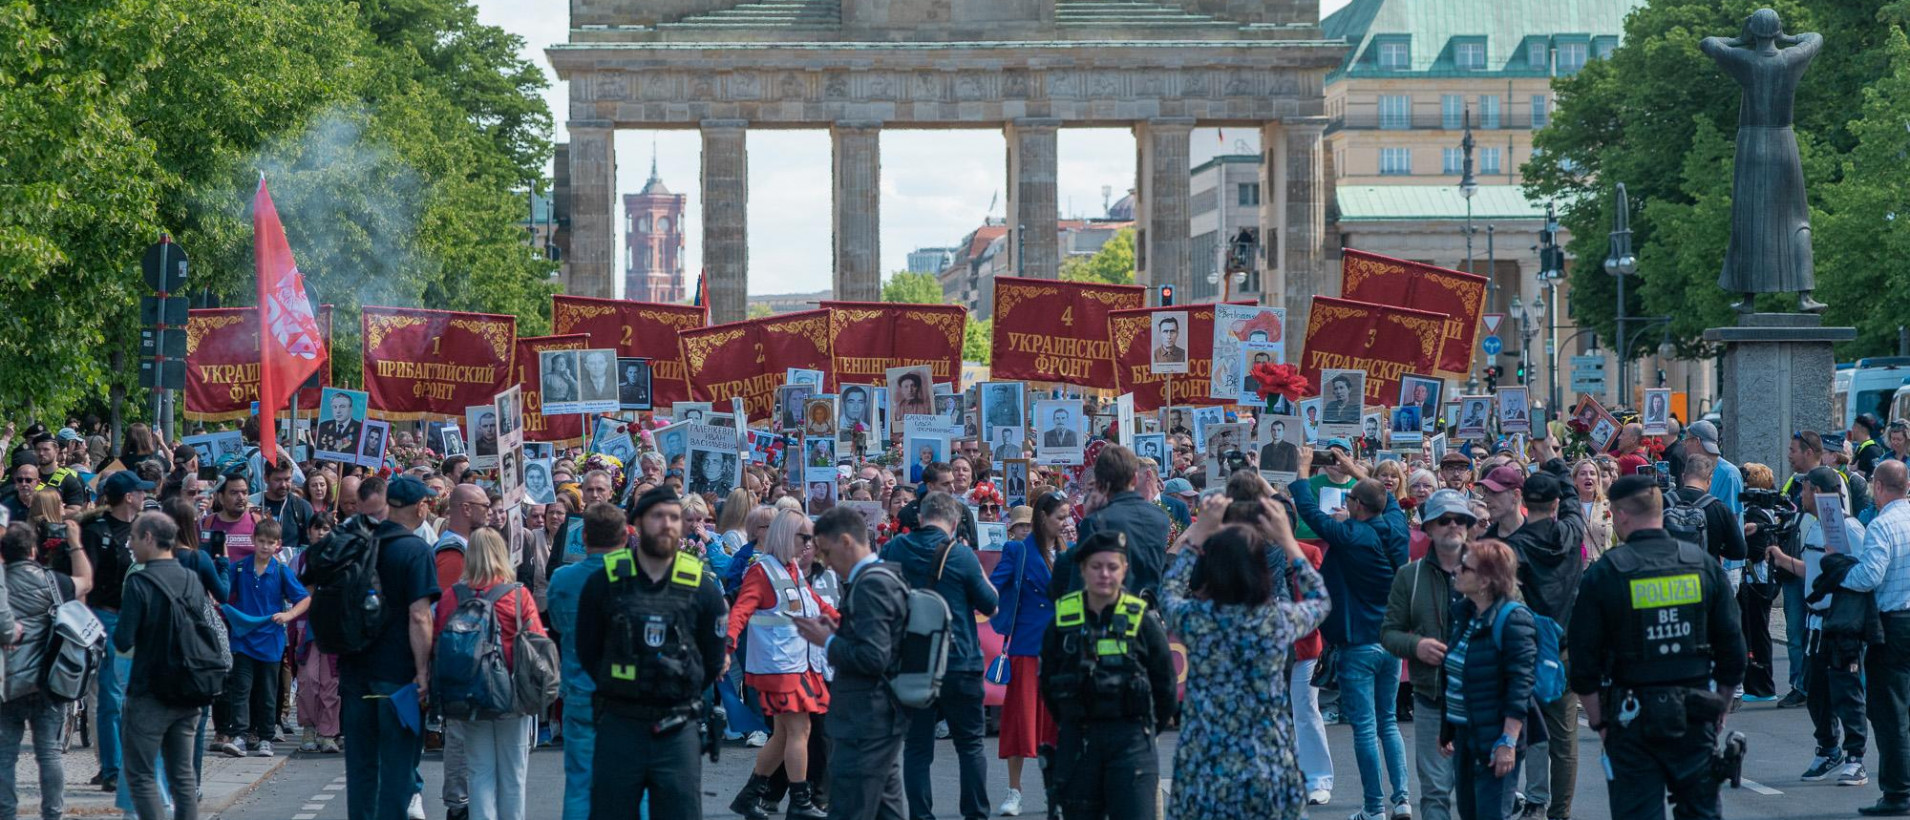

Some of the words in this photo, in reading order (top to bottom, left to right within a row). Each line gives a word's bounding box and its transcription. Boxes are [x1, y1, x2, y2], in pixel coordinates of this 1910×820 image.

[1061, 306, 1073, 326] 4
[252, 331, 260, 351] 1
[432, 336, 440, 355] 1
[621, 325, 633, 346] 2
[1364, 329, 1377, 348] 3
[755, 342, 765, 363] 2
[1008, 332, 1112, 360] УКРАИНСКИ
[199, 363, 260, 384] УКРАИ
[377, 360, 495, 384] ПРИБАЛТИЙСКИЙ
[518, 365, 526, 383] 1
[1035, 354, 1093, 378] ФРОНТ
[413, 380, 456, 400] ФРОНТ
[707, 368, 803, 403] УКРАИНС
[1635, 579, 1698, 604] POLIZEI
[1658, 607, 1679, 624] BE
[1646, 621, 1691, 640] 11110
